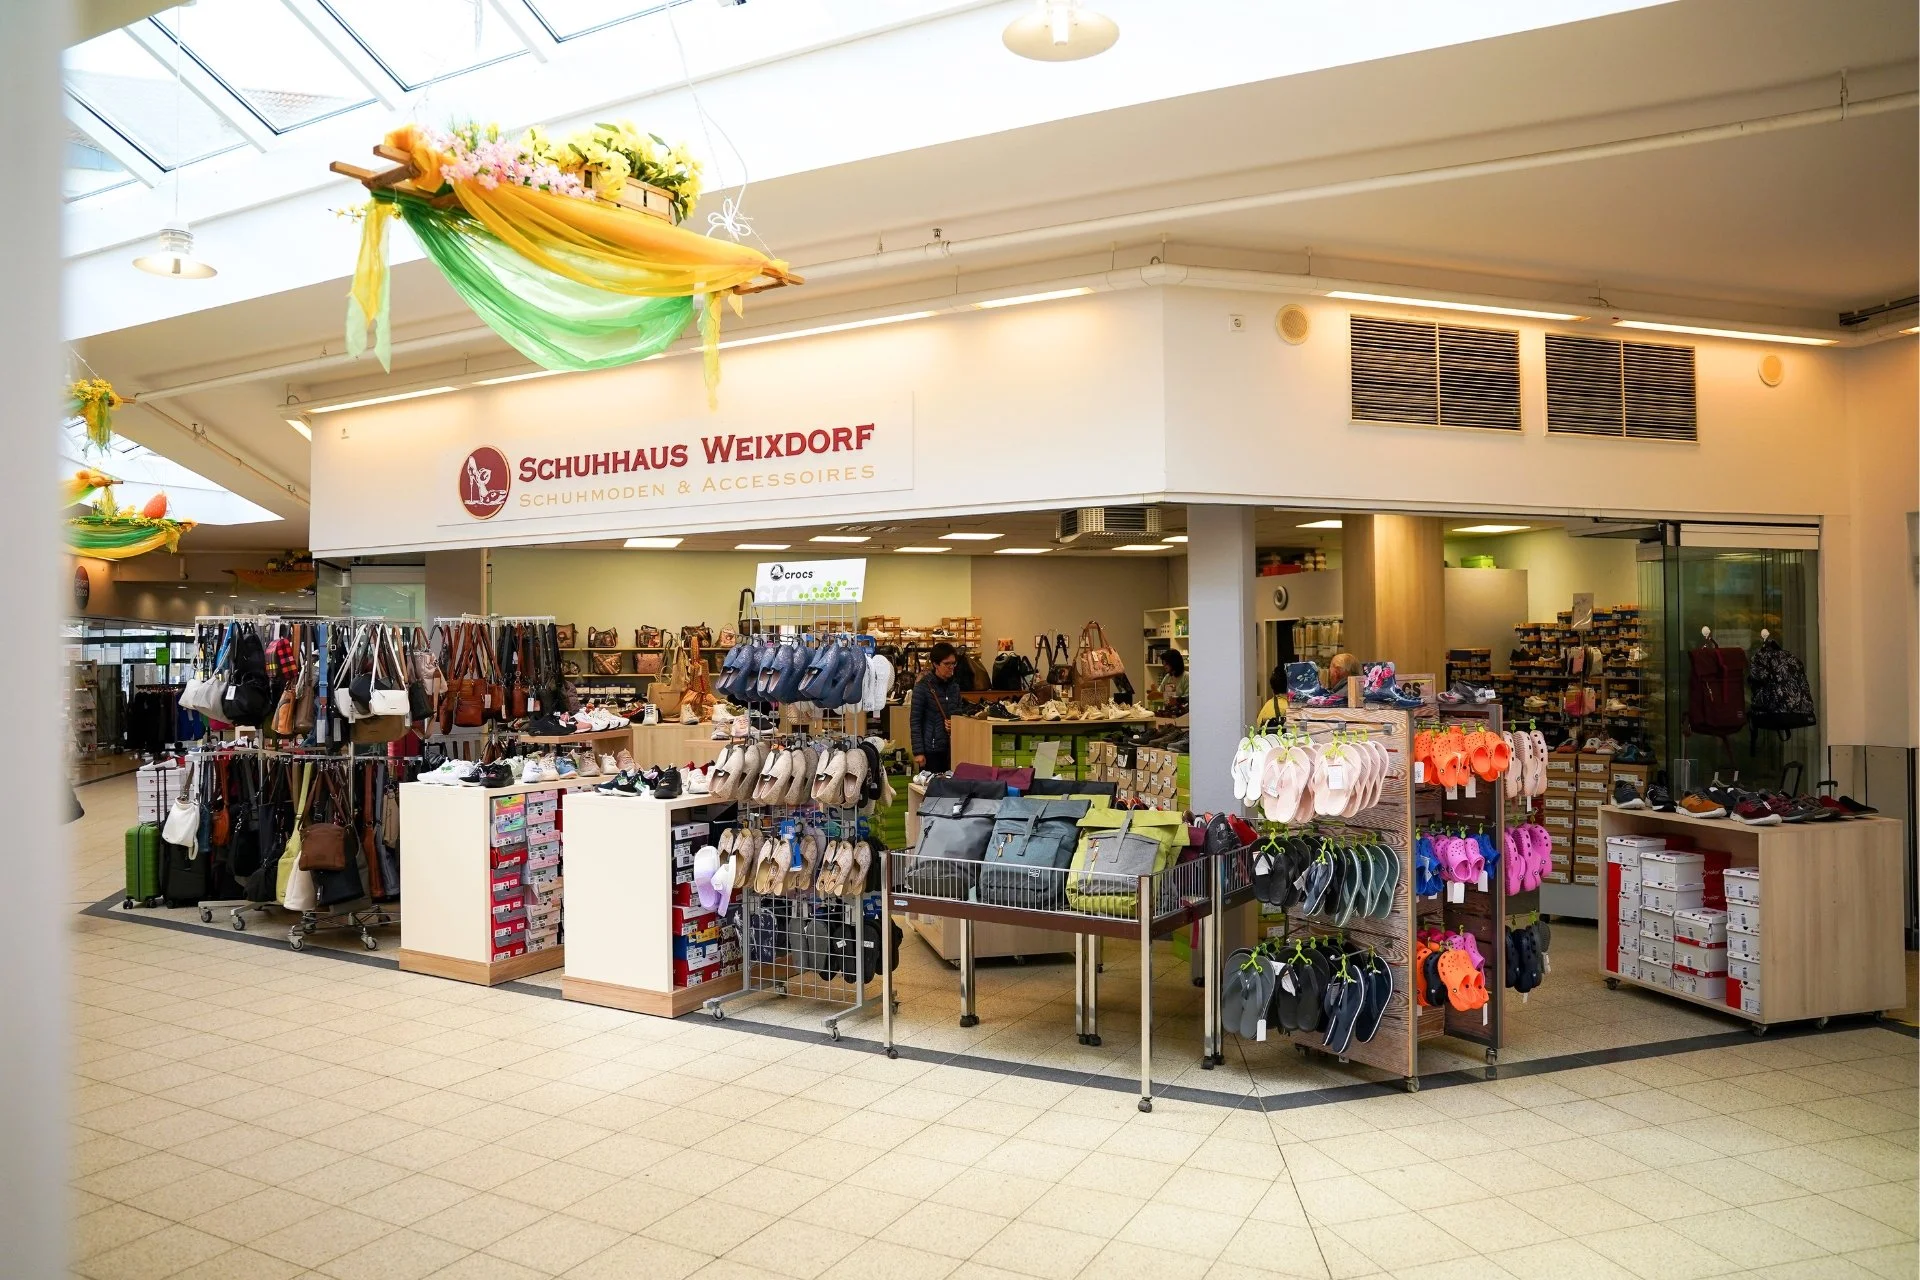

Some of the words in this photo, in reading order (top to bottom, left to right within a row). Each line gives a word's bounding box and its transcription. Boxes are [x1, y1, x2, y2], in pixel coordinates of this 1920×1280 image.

[519, 444, 688, 483] SCHUHHAUS
[701, 423, 875, 464] WEIXDORF
[519, 484, 665, 507] SCHUHMODEN
[677, 480, 691, 494] &
[702, 465, 875, 492] ACCESSOIRES
[784, 570, 814, 580] crocs
